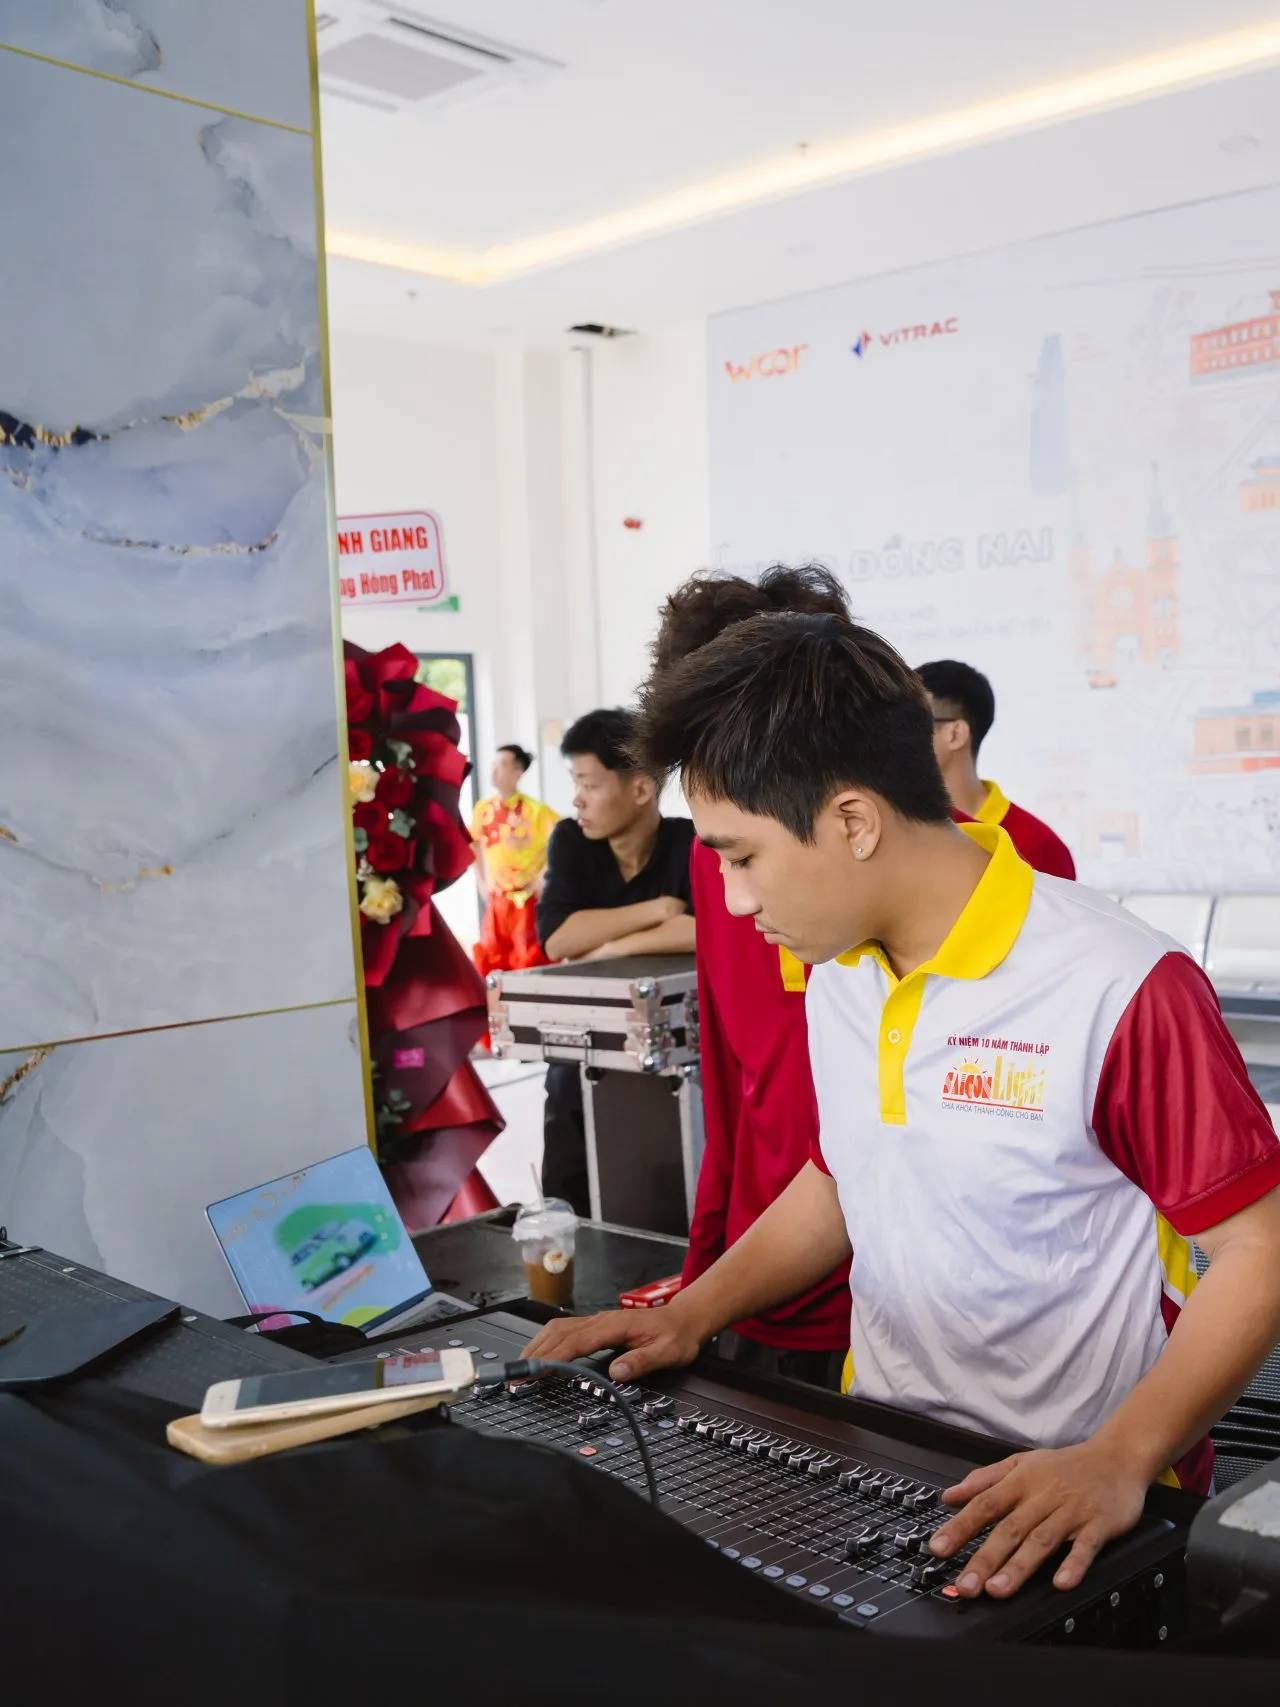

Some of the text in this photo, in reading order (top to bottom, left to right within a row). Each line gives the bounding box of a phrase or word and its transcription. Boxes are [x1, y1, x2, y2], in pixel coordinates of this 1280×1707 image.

[370, 526, 428, 553] GIANG
[977, 527, 1054, 569] NAI
[959, 1036, 979, 1048] NIỆM
[981, 1038, 990, 1048] 10
